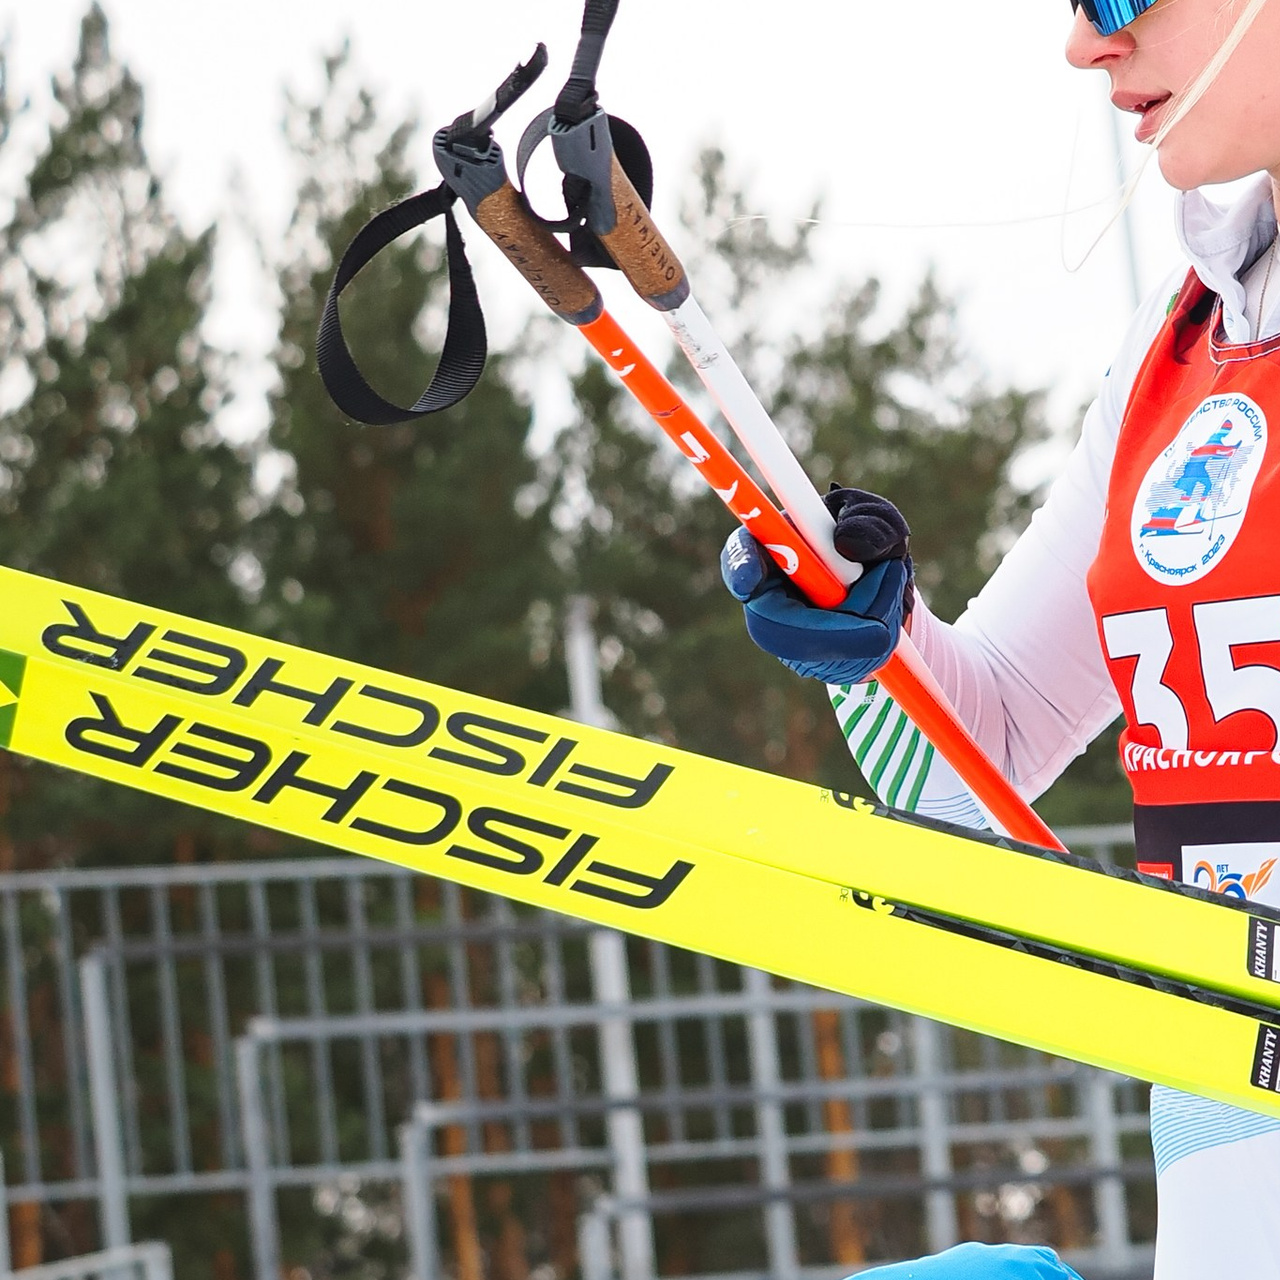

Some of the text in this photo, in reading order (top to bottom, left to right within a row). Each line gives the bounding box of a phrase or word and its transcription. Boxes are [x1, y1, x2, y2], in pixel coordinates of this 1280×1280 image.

[1232, 397, 1263, 442] РОССИИ
[1144, 549, 1197, 577] Красноярск
[1201, 534, 1225, 565] 2023
[41, 599, 675, 809] FISCHER
[65, 690, 695, 909] FISCHER
[1254, 921, 1268, 978] KHANTY
[1258, 1028, 1277, 1088] KHANTY
